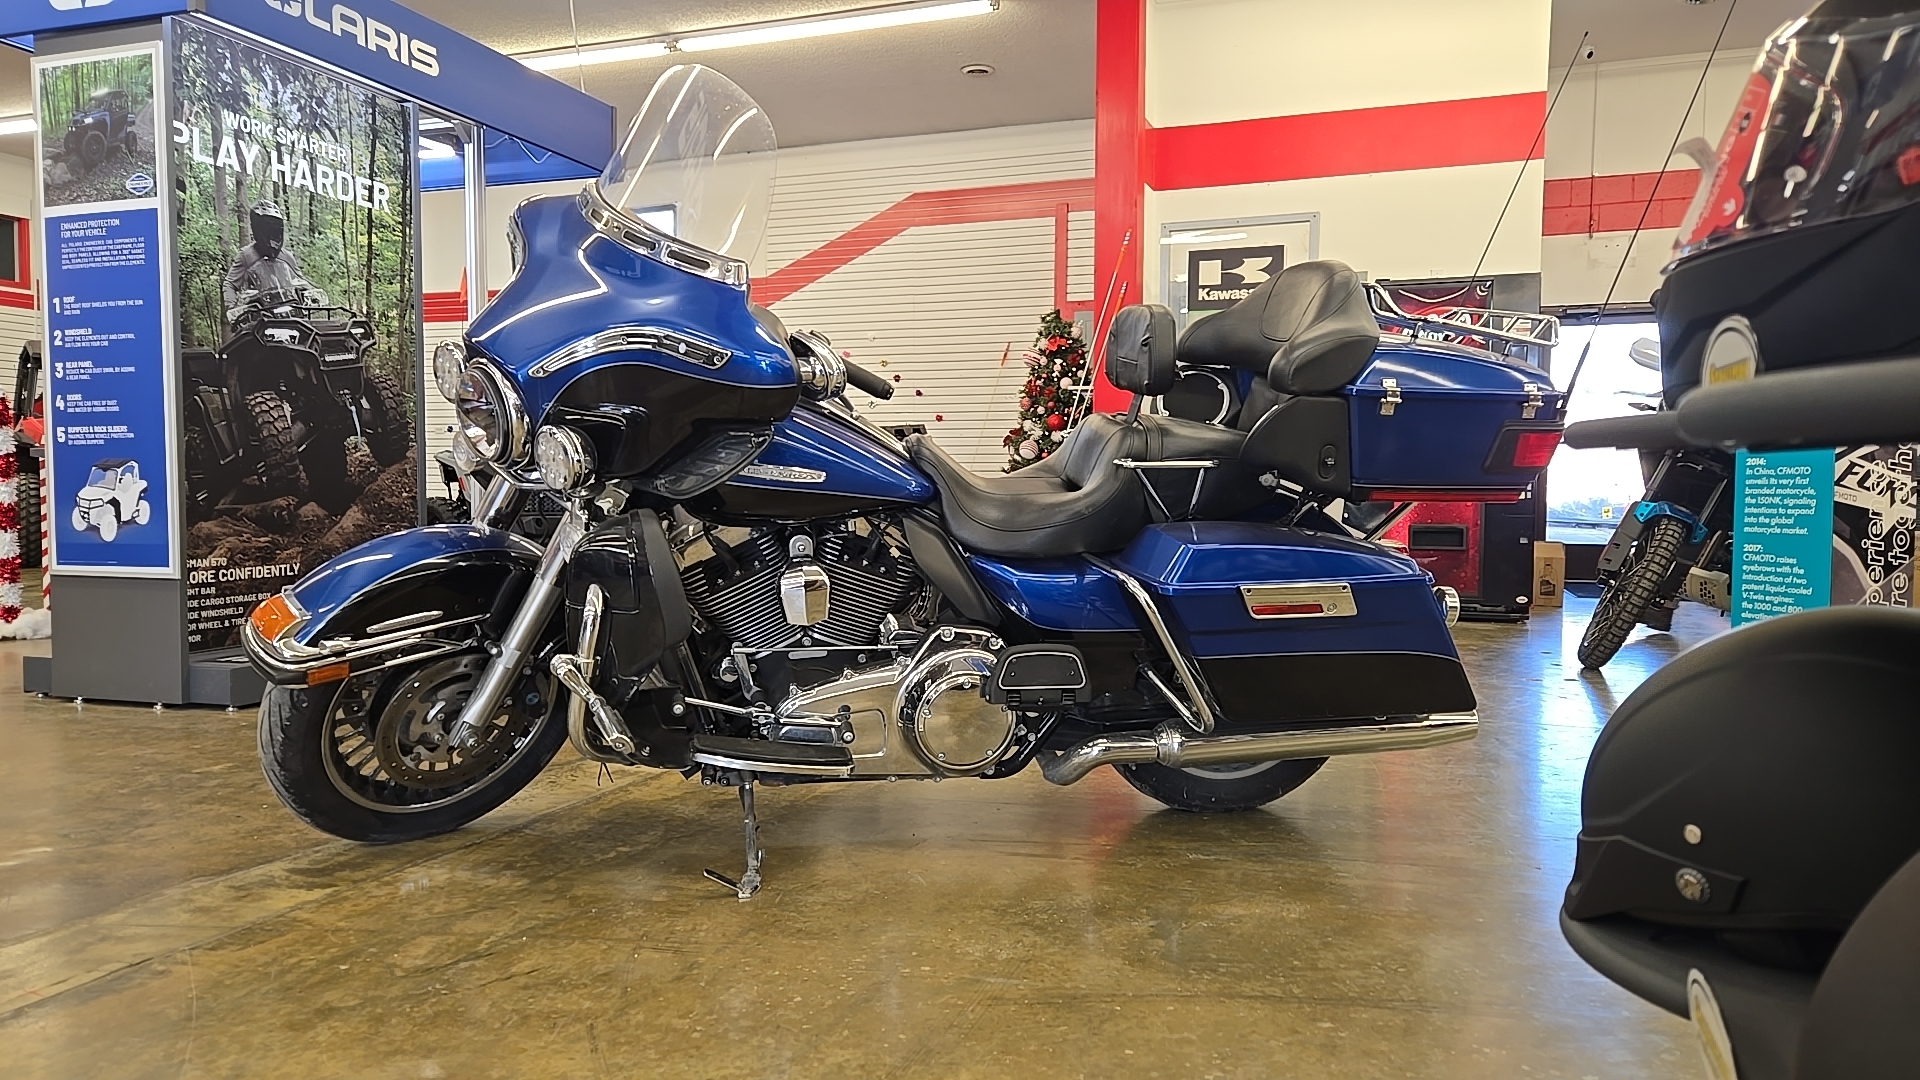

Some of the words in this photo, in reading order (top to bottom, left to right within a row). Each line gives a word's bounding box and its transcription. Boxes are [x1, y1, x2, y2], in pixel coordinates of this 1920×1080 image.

[265, 0, 440, 77] LARIS
[224, 110, 274, 139] WORK
[276, 127, 348, 163] SMARTER
[271, 149, 391, 214] HARDER
[60, 221, 88, 231] ENHANCED
[87, 218, 120, 228] PROTECTION
[71, 230, 85, 238] YOUR
[85, 228, 107, 236] VEHICLE
[53, 298, 60, 313] 1
[54, 330, 62, 345] 2
[55, 363, 63, 378] 3
[56, 395, 64, 410] 4
[57, 427, 65, 442] 5
[1745, 457, 1767, 466] 2014:
[1753, 467, 1776, 476] China,
[1776, 466, 1811, 475] CFMOTO
[1745, 477, 1768, 485] unveils
[1769, 477, 1777, 485] its
[1778, 478, 1794, 486] very
[1795, 476, 1809, 485] first
[1744, 486, 1775, 495] branded
[1776, 487, 1816, 496] motorcycle,
[1744, 496, 1756, 504] the
[1783, 497, 1816, 506] signaling
[1744, 506, 1777, 514] intentions
[1787, 507, 1815, 516] expand
[1758, 516, 1770, 524] the
[1770, 516, 1794, 525] global
[1744, 526, 1781, 535] motorcycle
[1782, 526, 1808, 535] market.
[1742, 544, 1764, 552] 2017:
[210, 557, 227, 567] 570
[1742, 553, 1776, 562] CFMOTO
[1776, 556, 1797, 564] raises
[218, 562, 300, 582] CONFIDENTLY
[1742, 563, 1775, 572] eyebrows
[1776, 566, 1791, 574] with
[1792, 567, 1804, 575] the
[1742, 573, 1783, 583] introduction
[1784, 575, 1793, 583] of
[200, 587, 216, 595] BAR
[1742, 583, 1765, 591] patent
[1765, 584, 1813, 595] liquid-cooled
[200, 598, 225, 606] CARGO
[226, 594, 257, 604] STORAGE
[257, 592, 271, 600] BOX
[1742, 592, 1764, 601] V-Twin
[1765, 595, 1795, 604] engines:
[200, 606, 244, 618] WINDSHIELD
[1741, 601, 1753, 609] the
[1754, 602, 1771, 610] 1000
[1787, 605, 1803, 613] 800
[198, 620, 223, 630] WHEEL
[224, 619, 230, 627] &
[231, 617, 247, 626] TIRE
